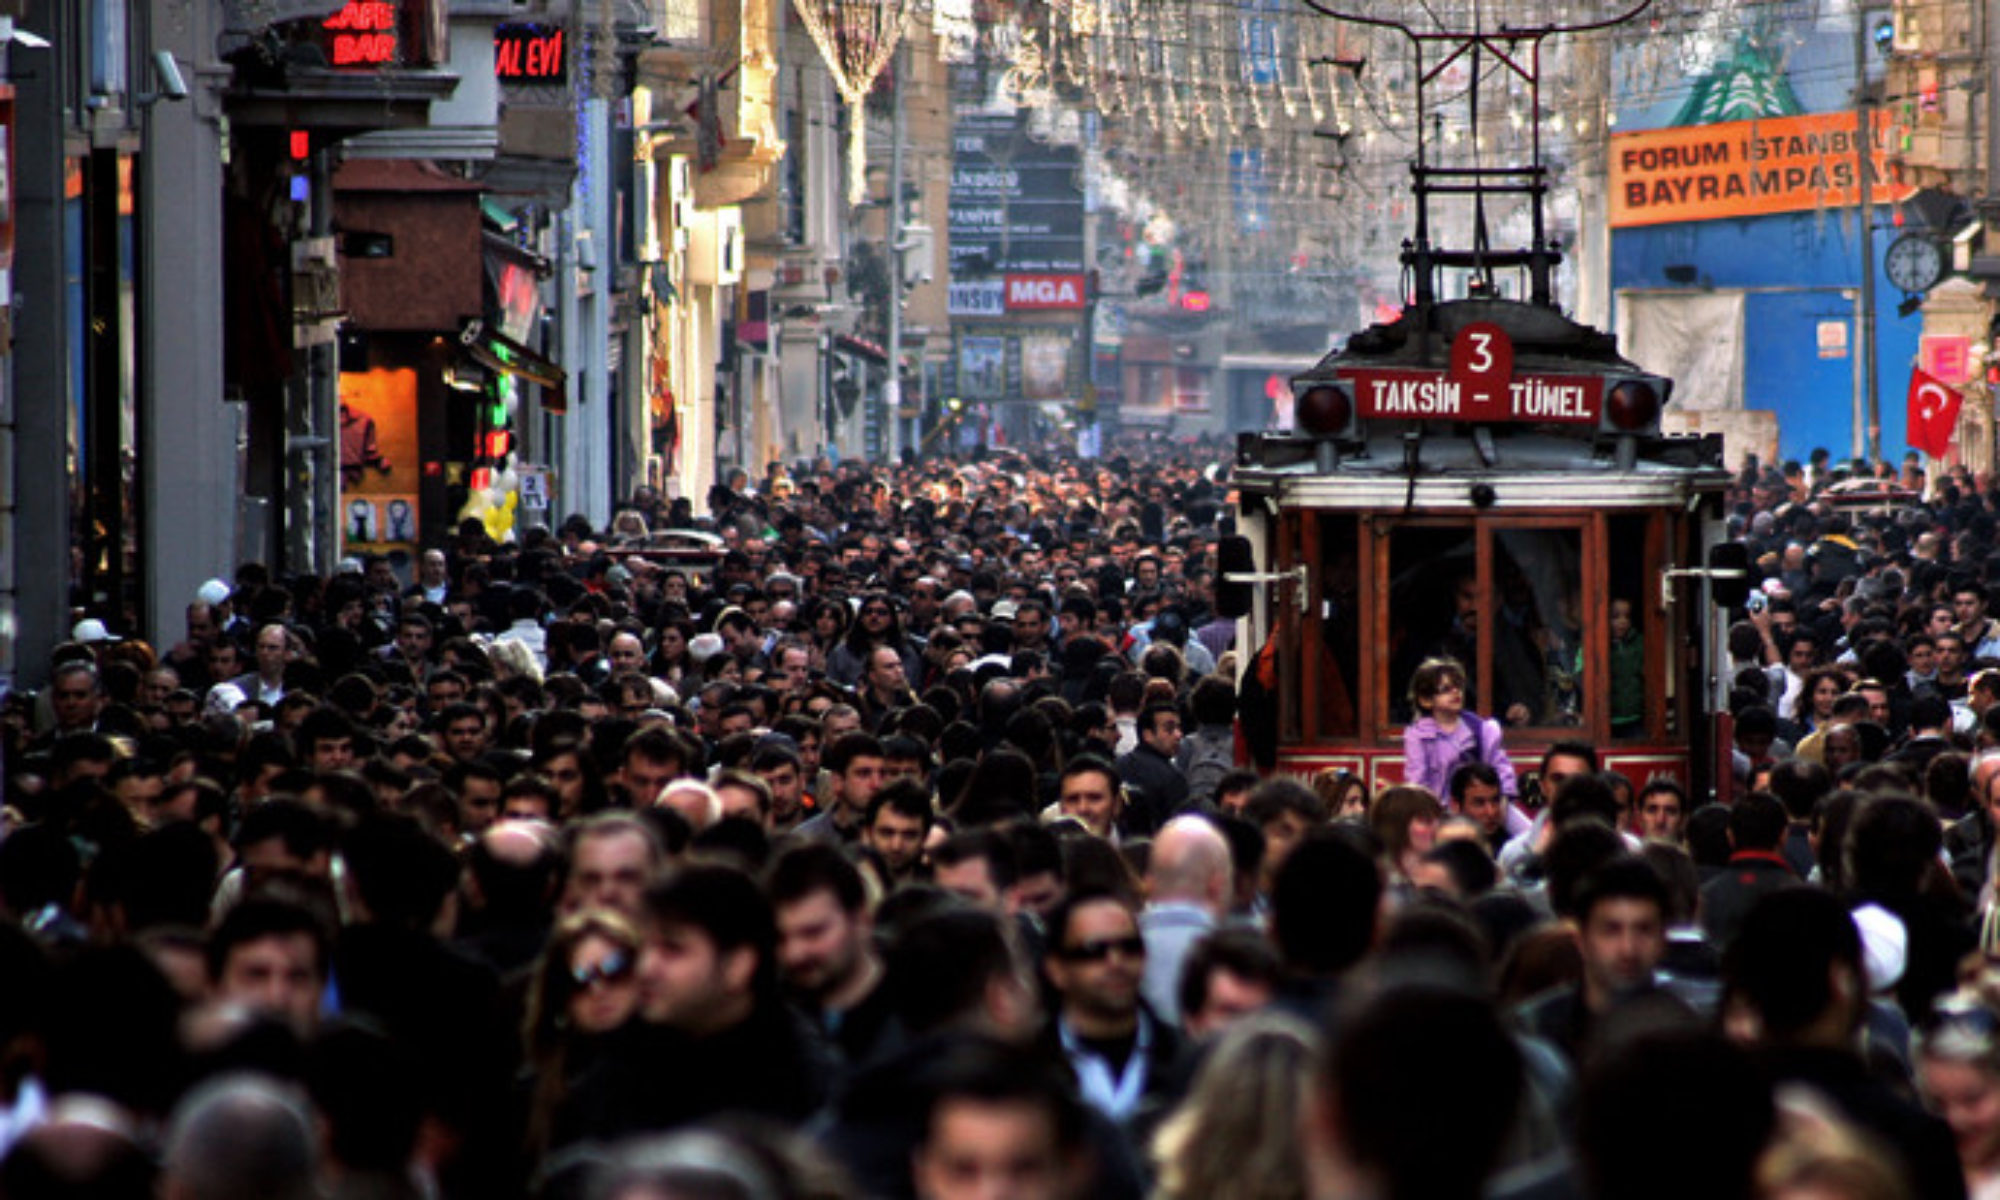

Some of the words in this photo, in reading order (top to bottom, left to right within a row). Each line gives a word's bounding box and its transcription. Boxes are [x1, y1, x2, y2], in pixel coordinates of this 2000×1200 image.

[333, 33, 396, 65] BAR
[1621, 141, 1729, 174] FORUM
[1010, 280, 1079, 303] MGA
[1468, 333, 1494, 373] 3
